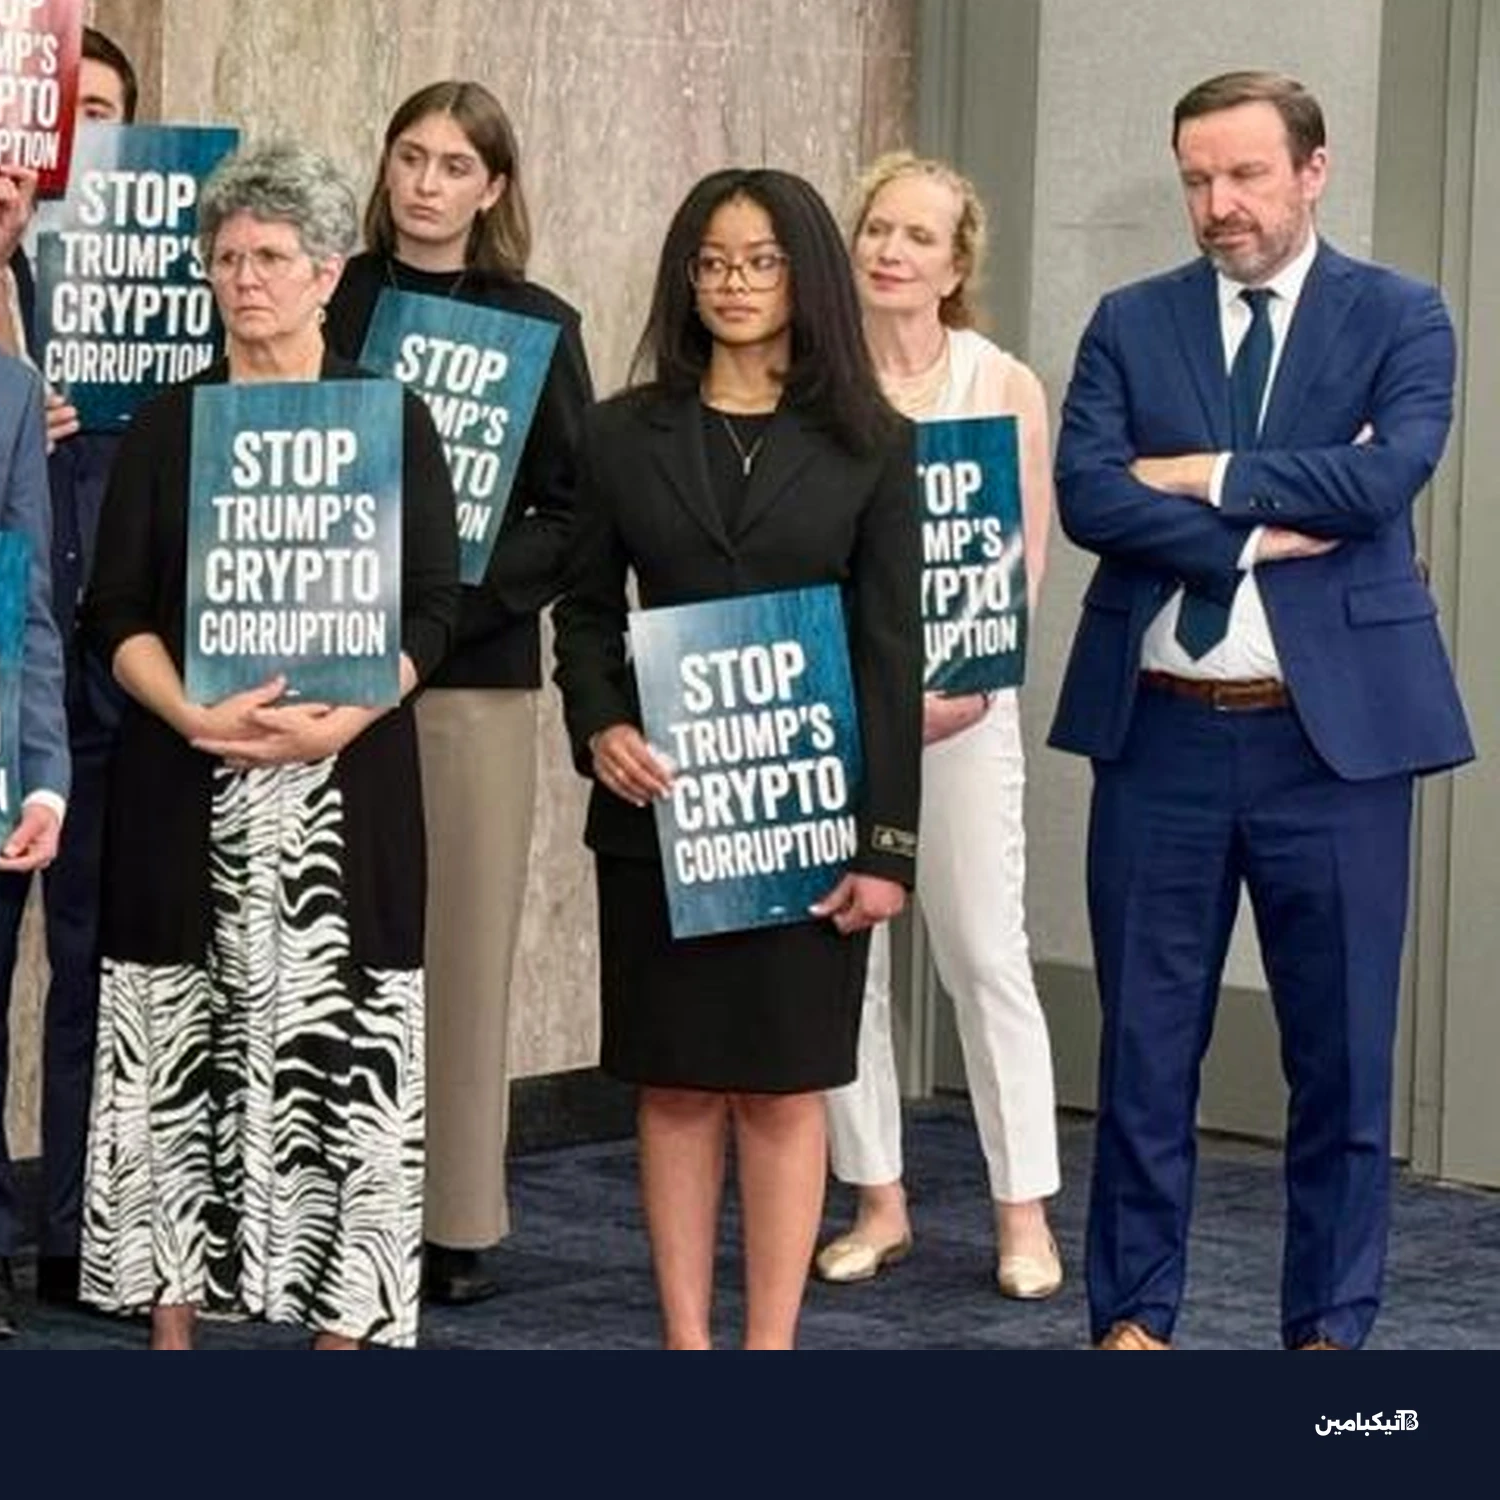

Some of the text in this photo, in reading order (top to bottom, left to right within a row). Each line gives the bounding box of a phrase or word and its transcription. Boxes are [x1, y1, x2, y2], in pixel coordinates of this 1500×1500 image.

[78, 169, 197, 229] STOP
[59, 231, 206, 280] TRUMP'S
[53, 282, 214, 337] CRYPTO
[45, 340, 214, 384] CORRUPTION
[394, 333, 509, 398] STOP
[232, 429, 358, 488] STOP
[212, 493, 376, 541] TRUMP'S
[922, 515, 1003, 563] MP'S
[206, 548, 380, 602] CRYPTO
[200, 610, 386, 657] CORRUPTION
[923, 614, 1018, 661] UPTION
[680, 641, 805, 713] STOP
[668, 703, 836, 769] TRUMP'S
[671, 756, 848, 832] CRYPTO
[675, 815, 858, 885] CORRUPTION
